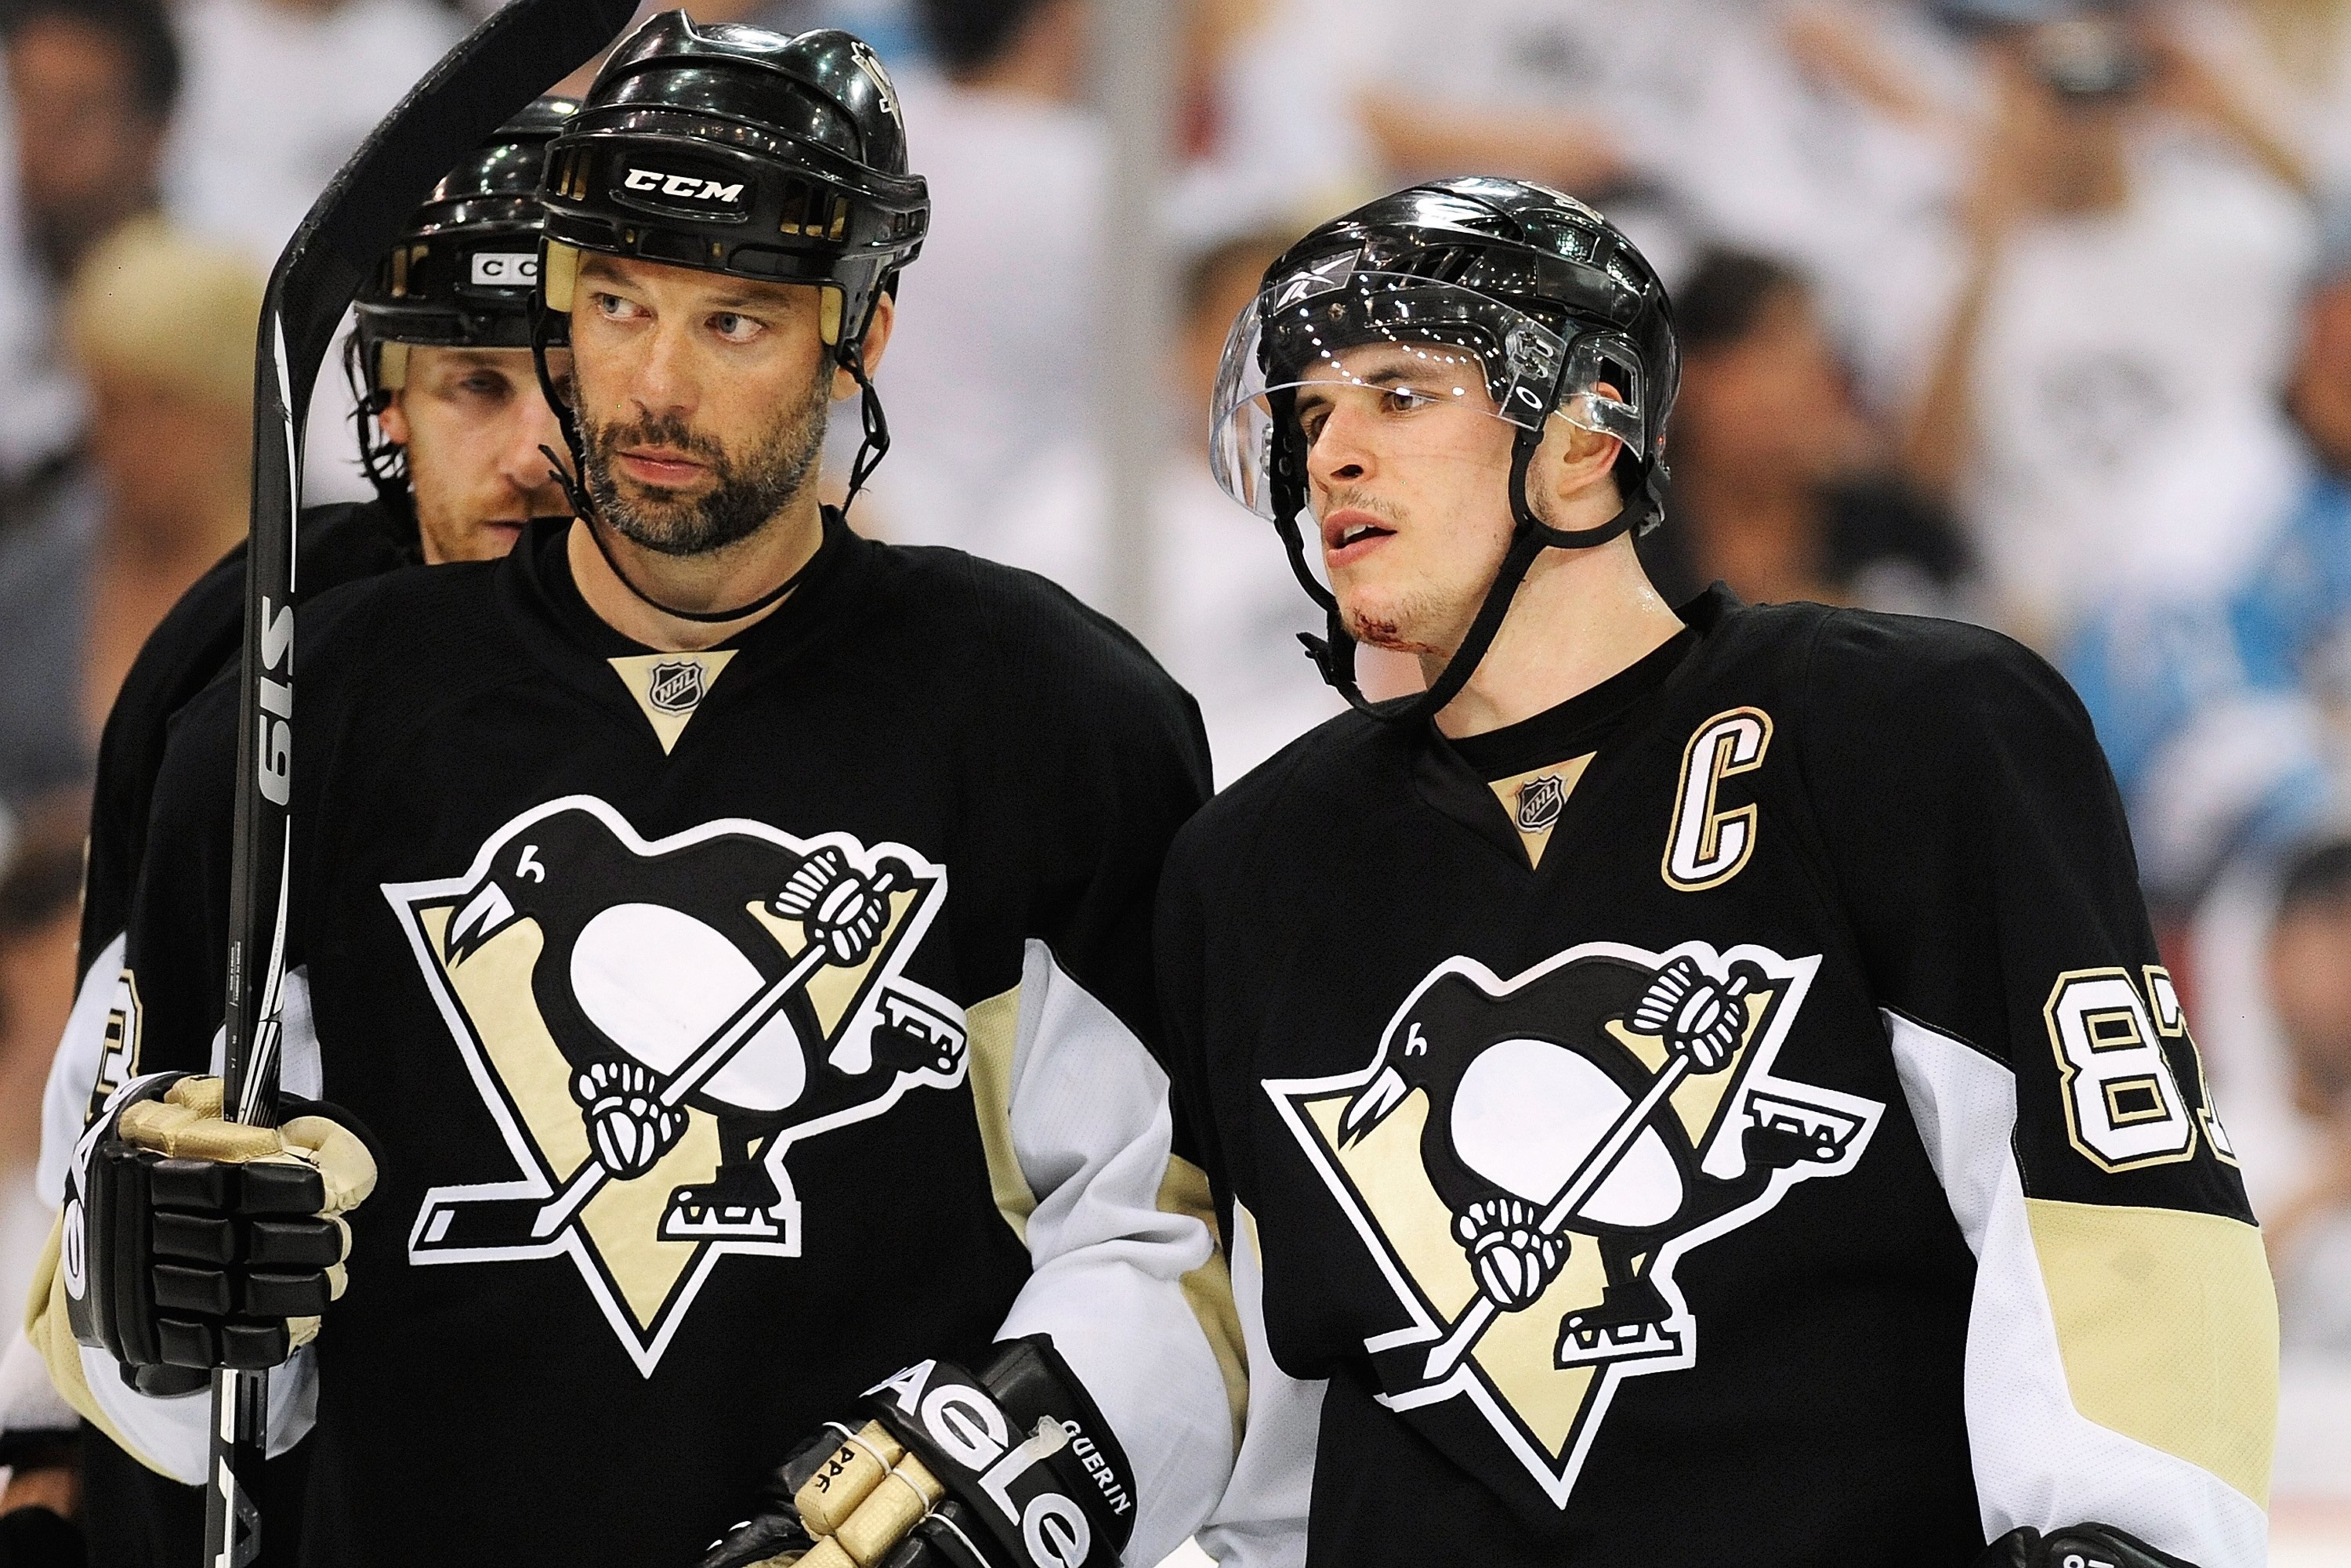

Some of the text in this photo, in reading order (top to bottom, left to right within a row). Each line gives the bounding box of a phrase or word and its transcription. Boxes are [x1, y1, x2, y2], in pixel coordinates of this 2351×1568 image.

[625, 168, 744, 202] CCM
[483, 260, 538, 277] CC
[259, 596, 294, 806] S19
[660, 672, 696, 702] NHL
[1526, 785, 1555, 822] NHL
[1661, 706, 1773, 892] C
[814, 1446, 856, 1494] PPF
[1061, 1419, 1132, 1517] GUERIN
